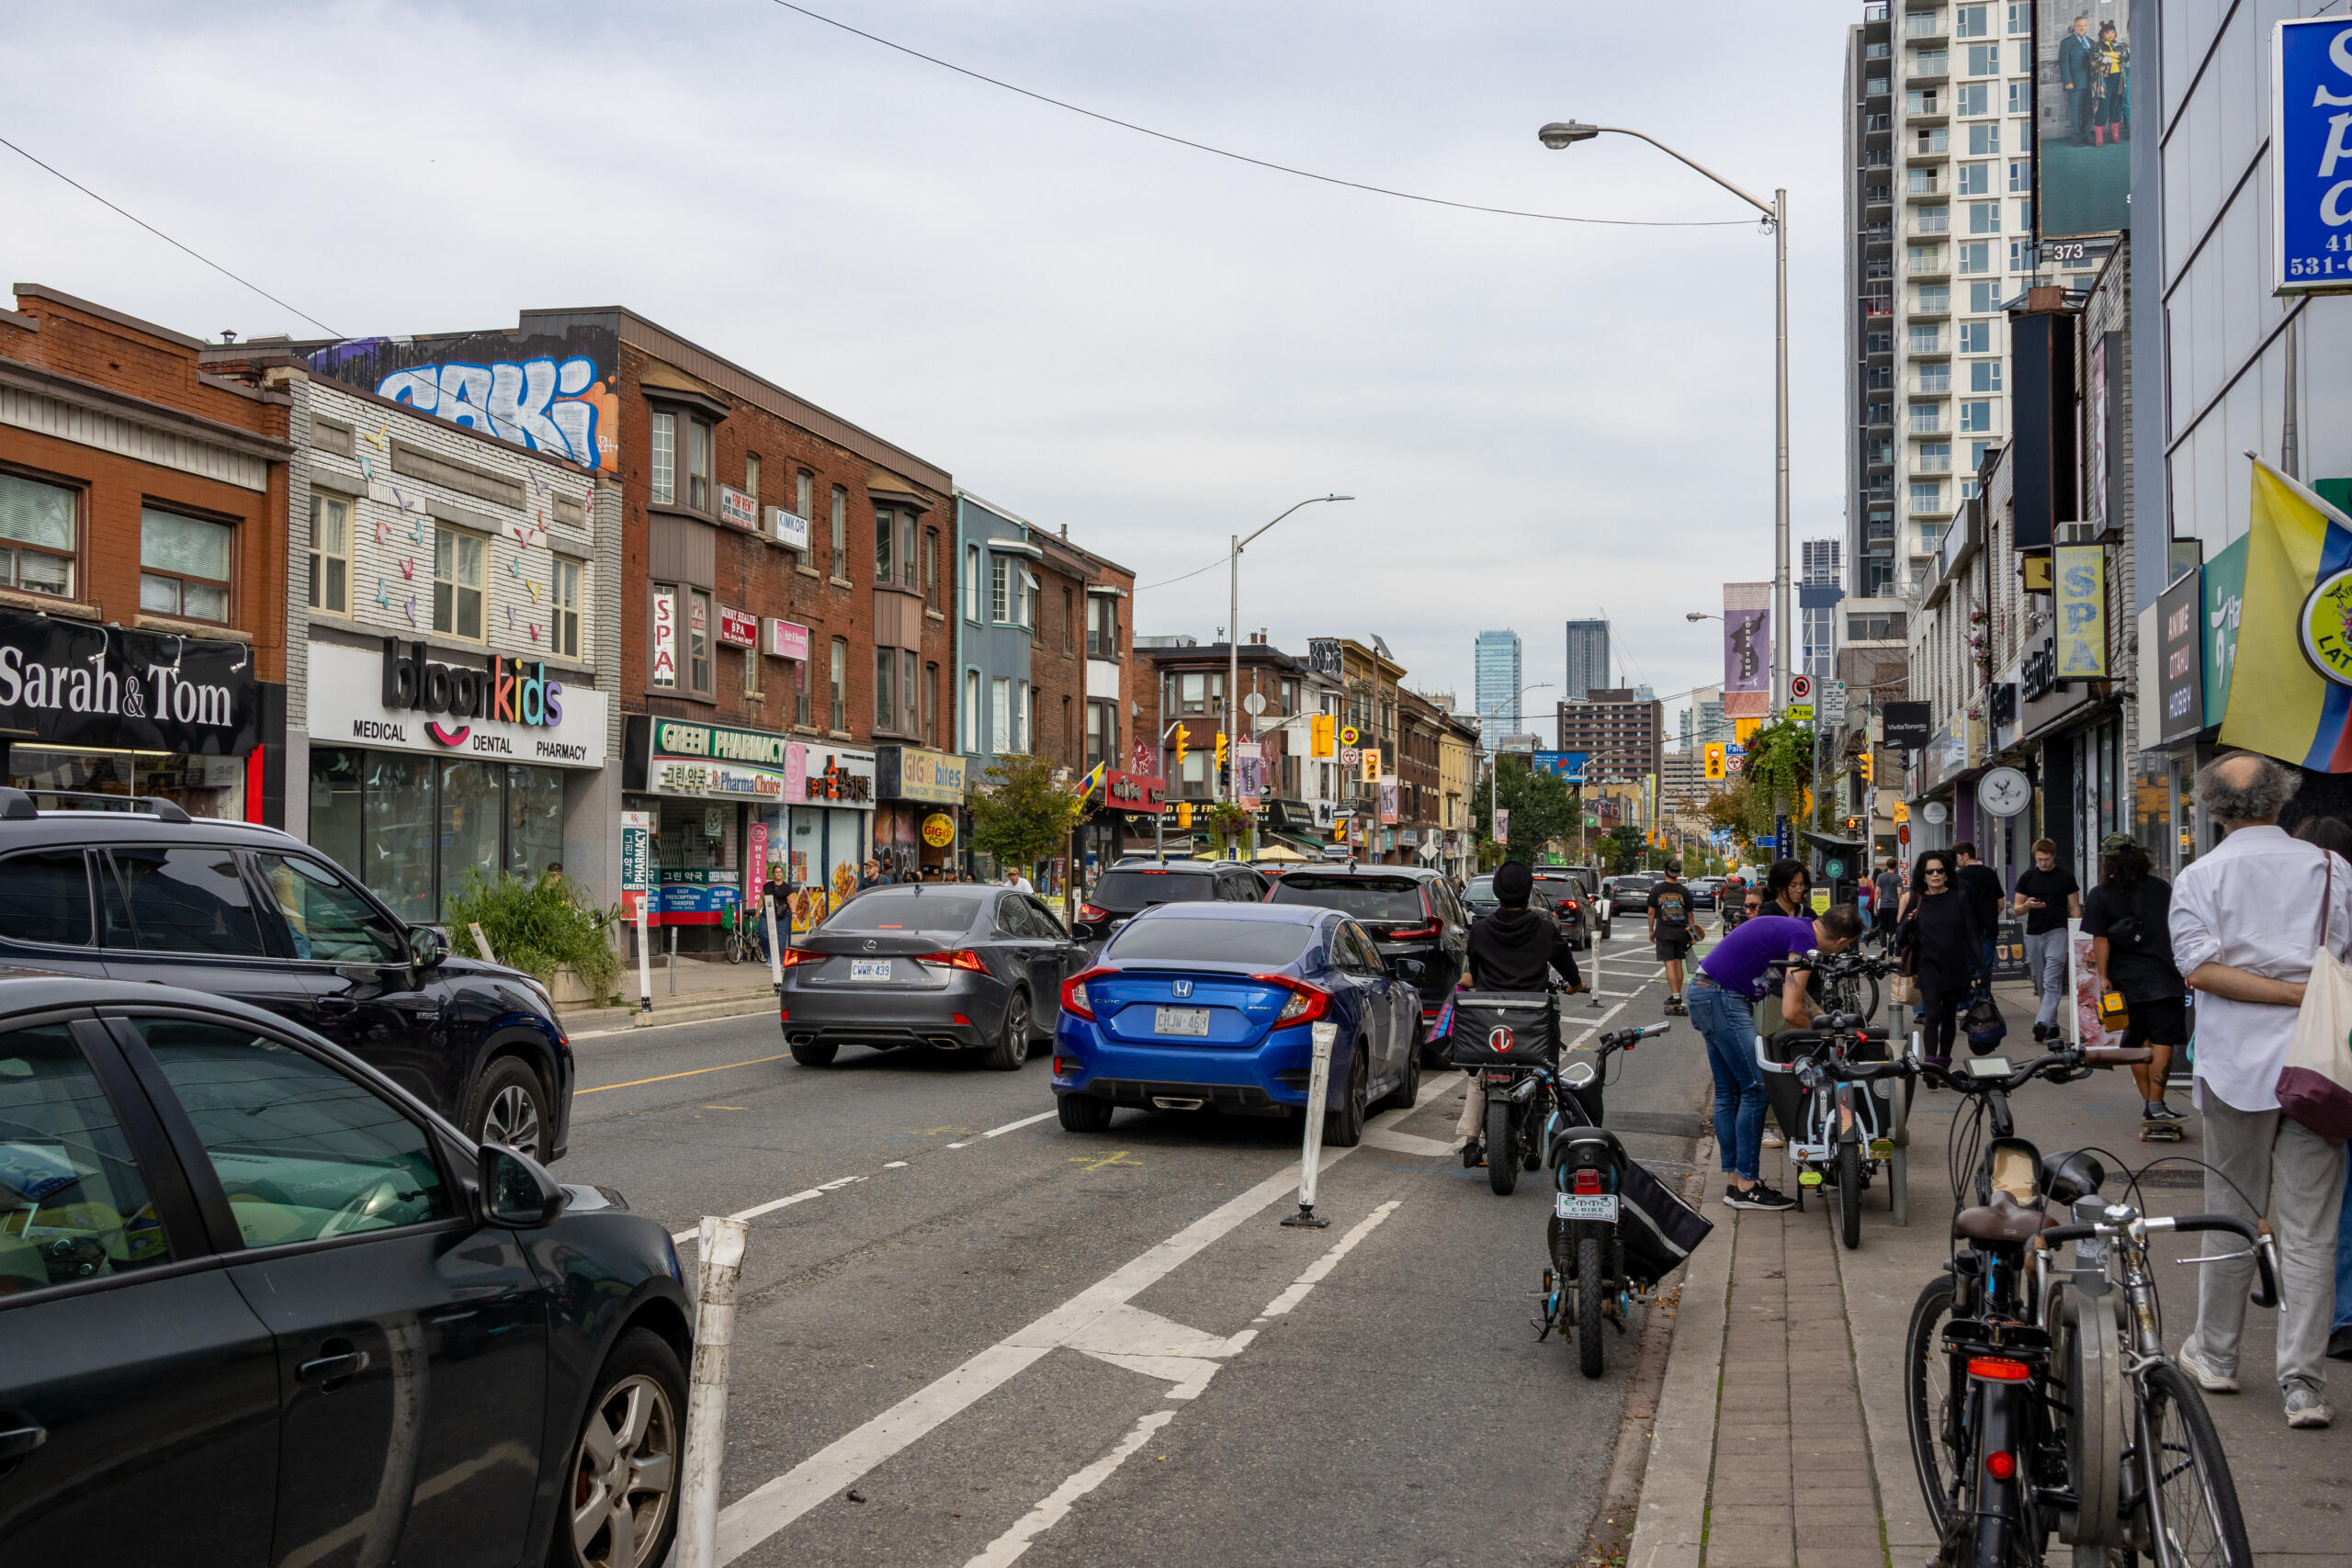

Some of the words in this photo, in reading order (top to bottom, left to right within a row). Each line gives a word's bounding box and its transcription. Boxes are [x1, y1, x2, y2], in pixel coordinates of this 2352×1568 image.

[2054, 243, 2083, 260] 373
[732, 493, 741, 508] FOR
[742, 497, 754, 514] RENT
[778, 512, 806, 535] KIMKOR
[654, 600, 673, 671] SPA
[731, 622, 745, 634] SPA
[737, 609, 756, 626] HEALTH
[2063, 565, 2100, 672] SPA
[2168, 603, 2189, 643] ANIME
[0, 646, 119, 714] Sarah
[123, 676, 145, 718] &
[147, 663, 232, 727] Tom
[382, 636, 562, 728] bloorkids
[2169, 683, 2191, 720] HOBBY
[353, 720, 406, 742] MEDICAL
[473, 735, 513, 754] DENTAL
[537, 741, 586, 761] PHARMACY
[661, 723, 710, 756] GREEN
[714, 730, 786, 763] PHARMACY
[634, 830, 646, 883] PHARMACY
